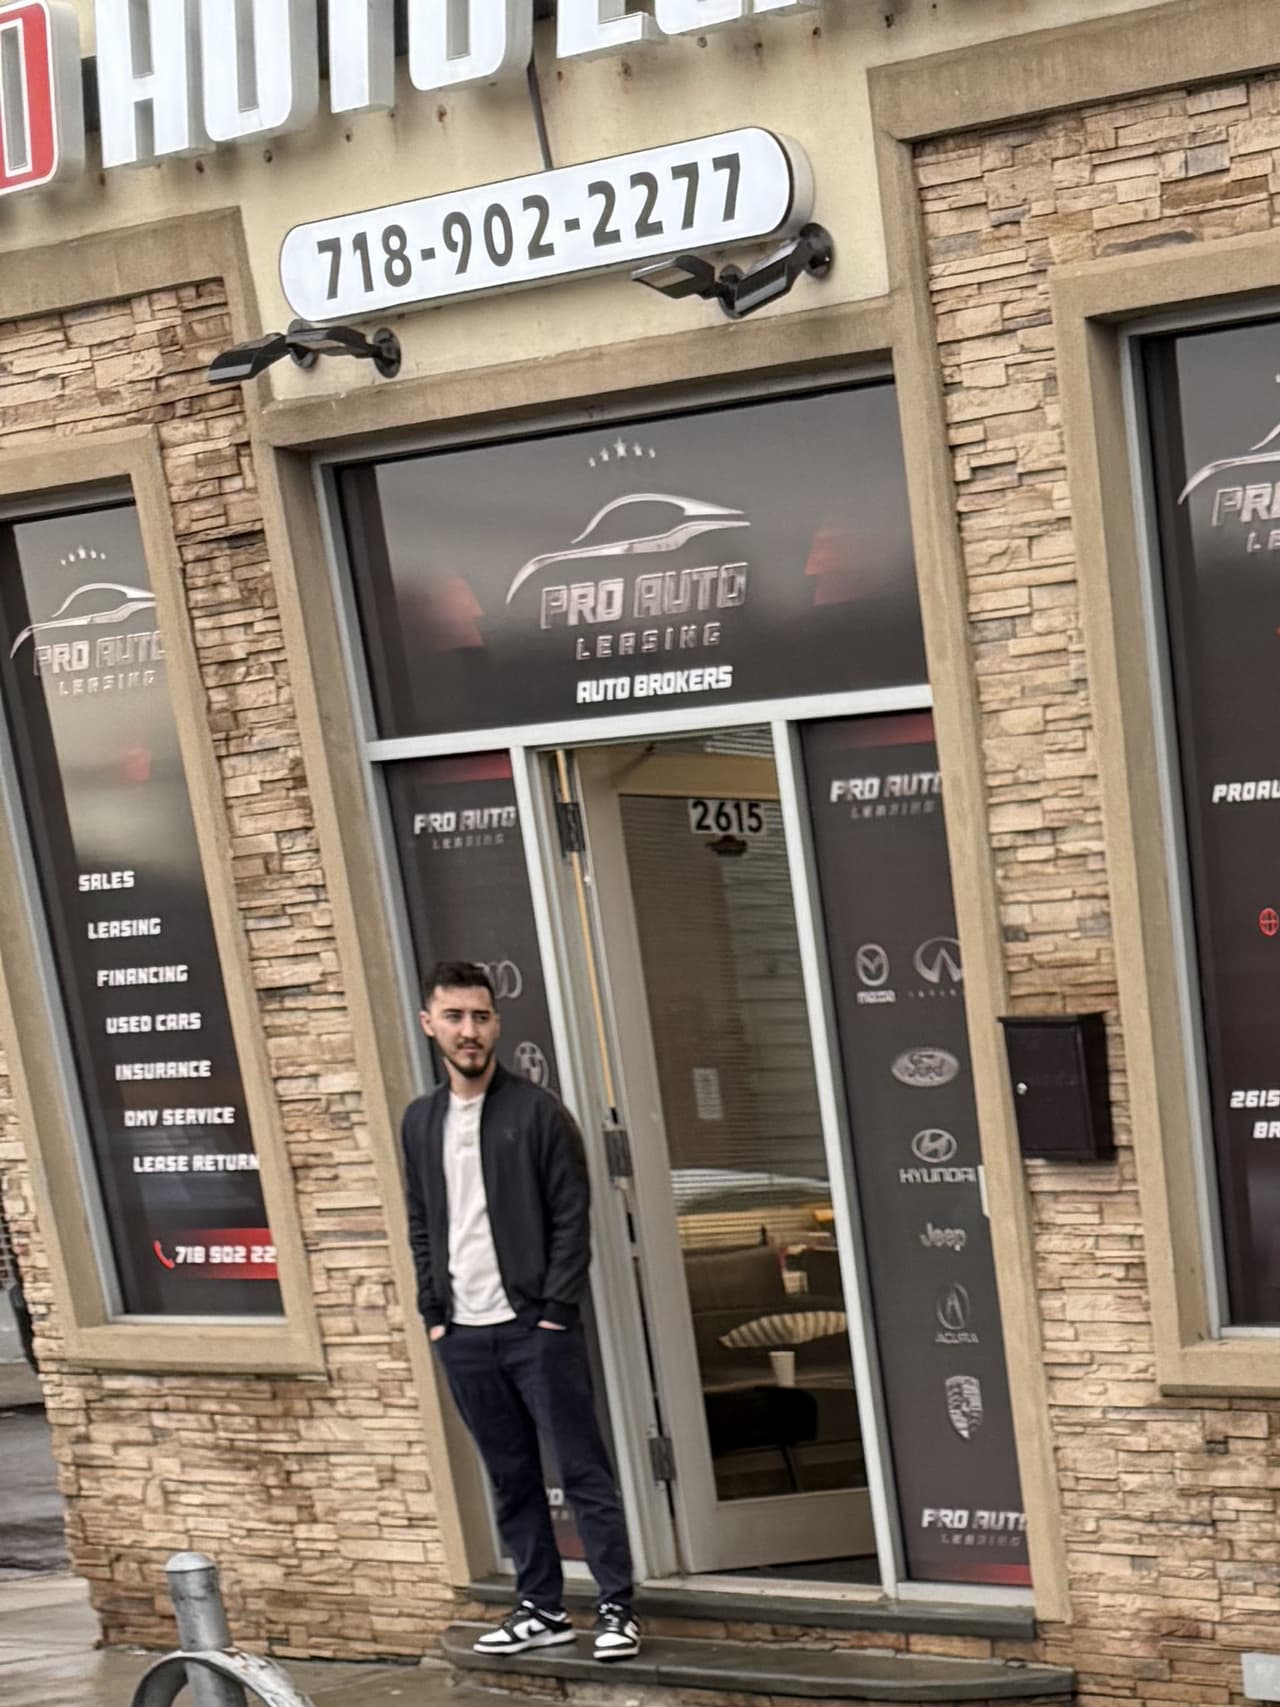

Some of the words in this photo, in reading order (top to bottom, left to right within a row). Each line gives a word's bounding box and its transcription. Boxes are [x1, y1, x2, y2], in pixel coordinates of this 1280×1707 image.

[316, 153, 742, 301] 718-902-2277
[540, 578, 625, 629] PRO
[633, 562, 748, 618] AUTO
[575, 622, 721, 660] LEASING
[33, 640, 90, 676] PRO
[59, 670, 156, 696] LEASING
[576, 676, 631, 704] AUTO
[633, 665, 733, 698] BROKERS
[829, 777, 881, 802] PRO
[413, 811, 455, 834] PRO
[459, 806, 516, 831] AUTO
[692, 801, 763, 833] 2615
[78, 870, 136, 891] SALES
[88, 918, 161, 939] LEASING
[97, 965, 189, 987] FINANCING
[106, 1015, 152, 1034] USED
[155, 1013, 201, 1032] CARS
[115, 1060, 212, 1081] INSURANCE
[1230, 1090, 1280, 1109] 2615
[124, 1110, 158, 1127] DMV
[162, 1107, 235, 1125] SERVICE
[133, 1156, 189, 1173] LEASE
[899, 1167, 977, 1183] HYUNDAI
[920, 1222, 966, 1252] Jeep
[175, 1246, 205, 1264] 718
[209, 1246, 246, 1264] 902
[935, 1331, 980, 1345] ACURA
[921, 1508, 968, 1529] PRO
